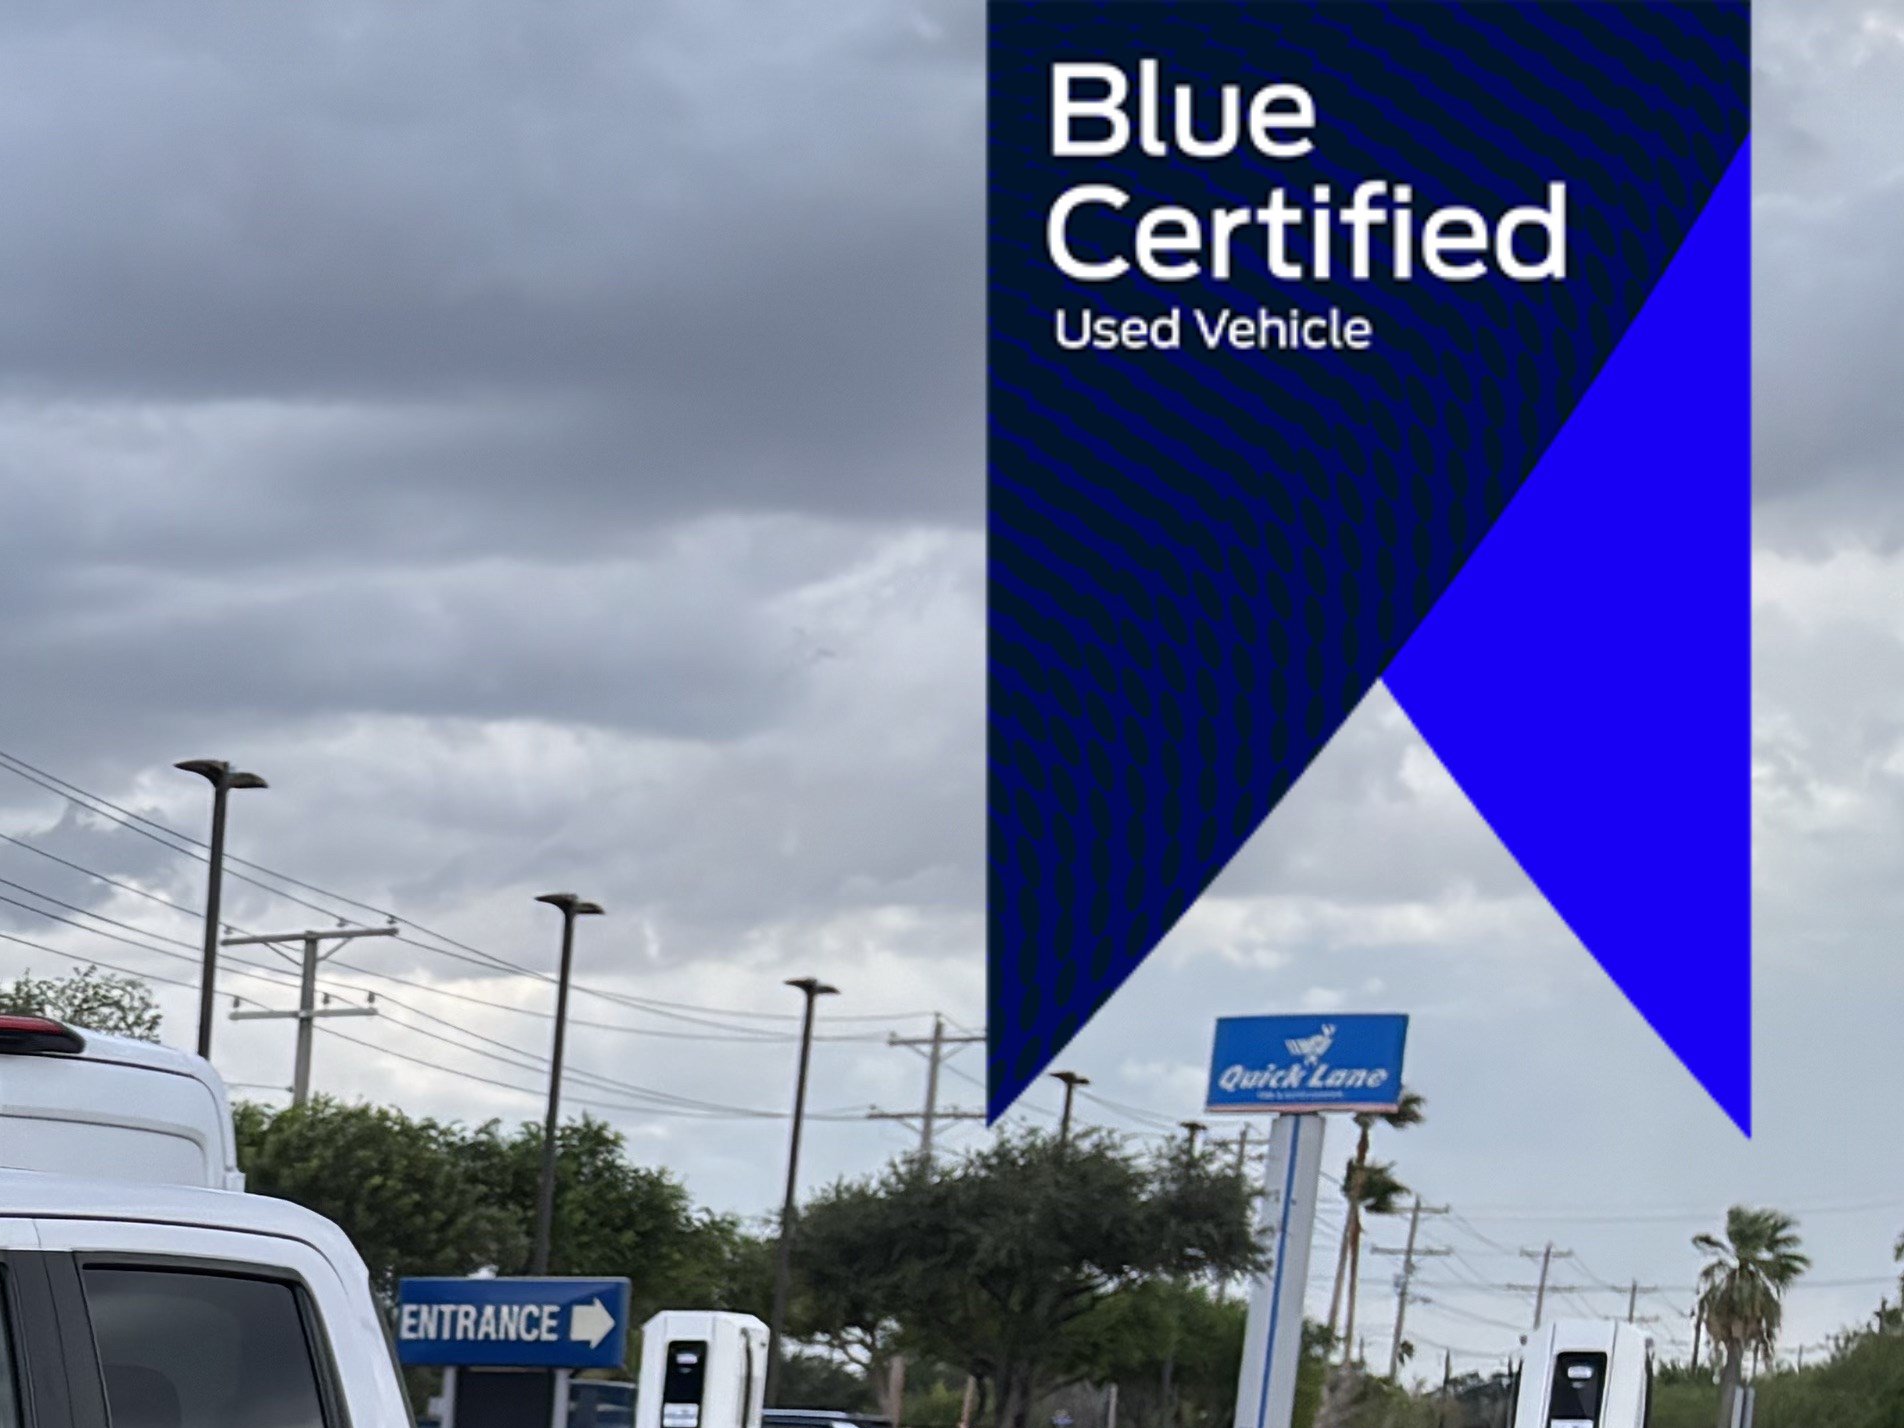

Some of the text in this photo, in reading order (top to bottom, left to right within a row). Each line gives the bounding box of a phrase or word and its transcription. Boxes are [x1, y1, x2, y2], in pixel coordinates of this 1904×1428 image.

[1219, 1063, 1389, 1092] Quick Lane
[399, 1303, 561, 1342] ENTRANCE
